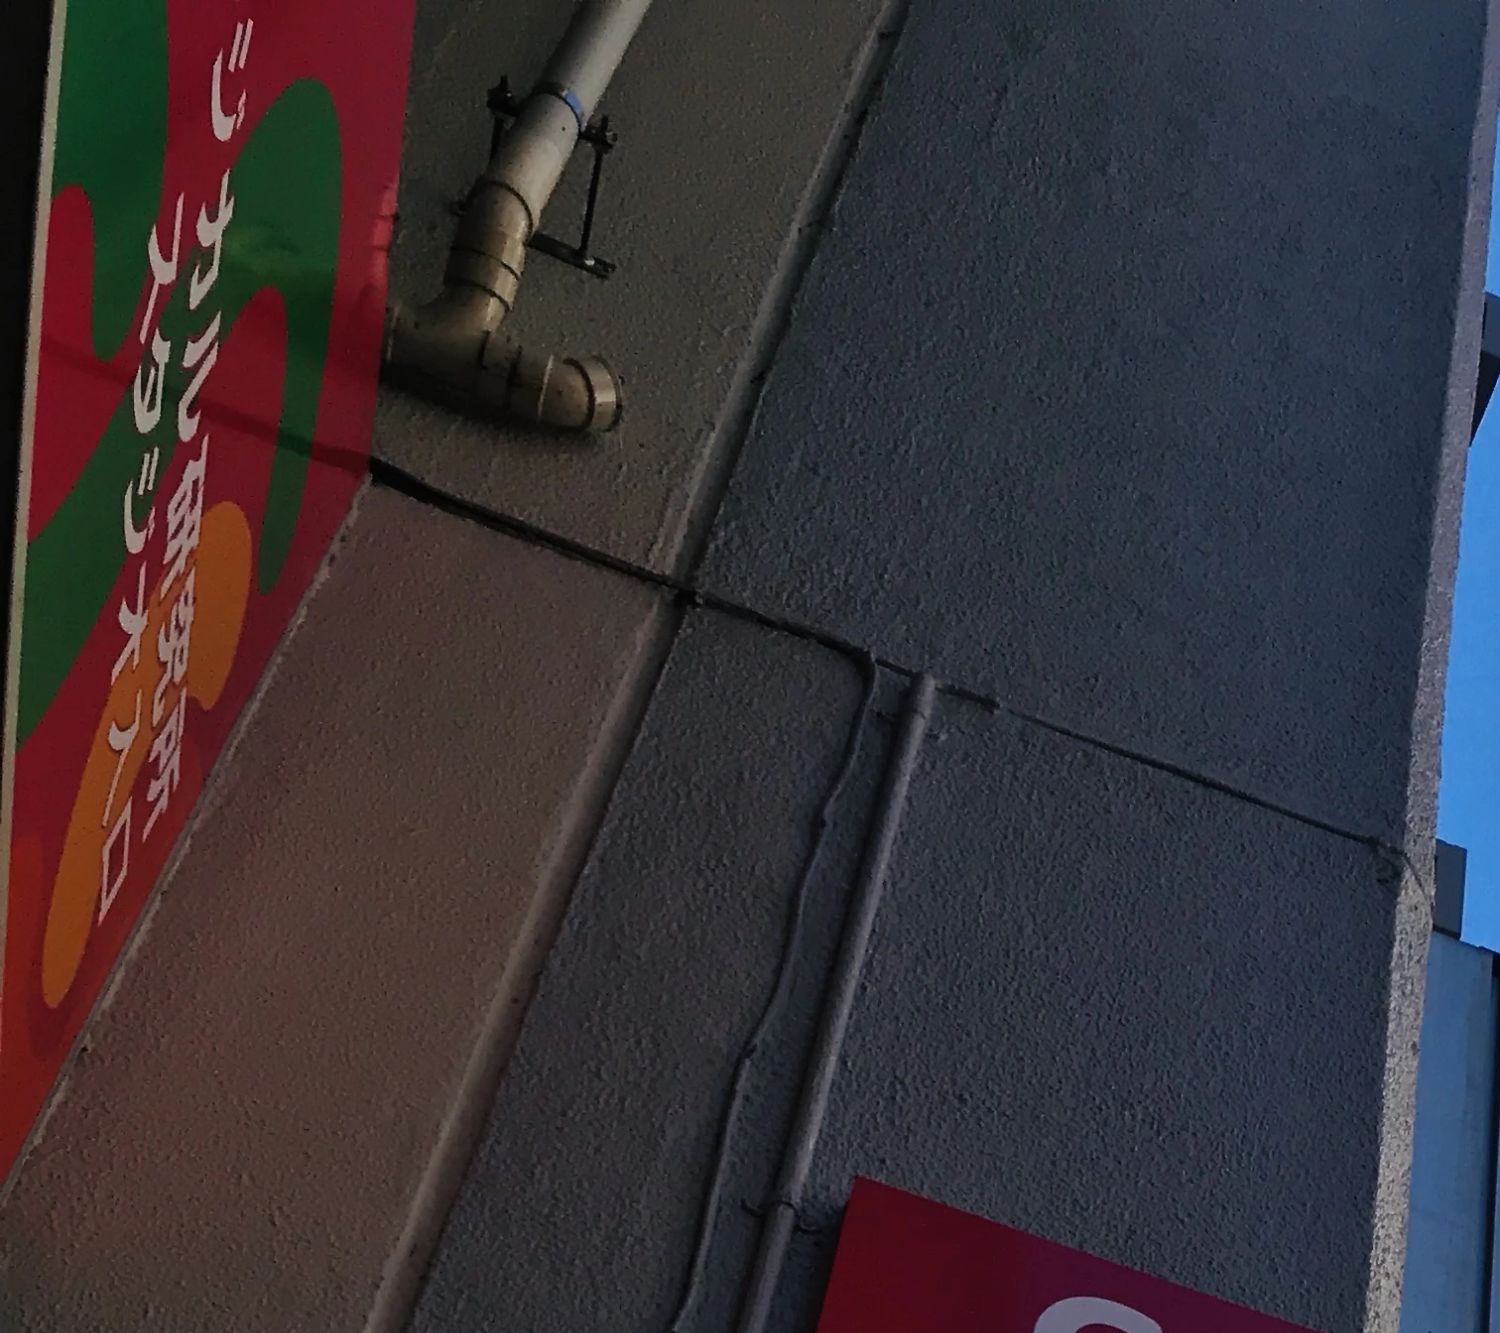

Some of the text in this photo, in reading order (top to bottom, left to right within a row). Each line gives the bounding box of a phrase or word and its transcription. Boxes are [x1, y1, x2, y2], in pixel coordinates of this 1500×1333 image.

[97, 191, 184, 927] スタジオ入口
